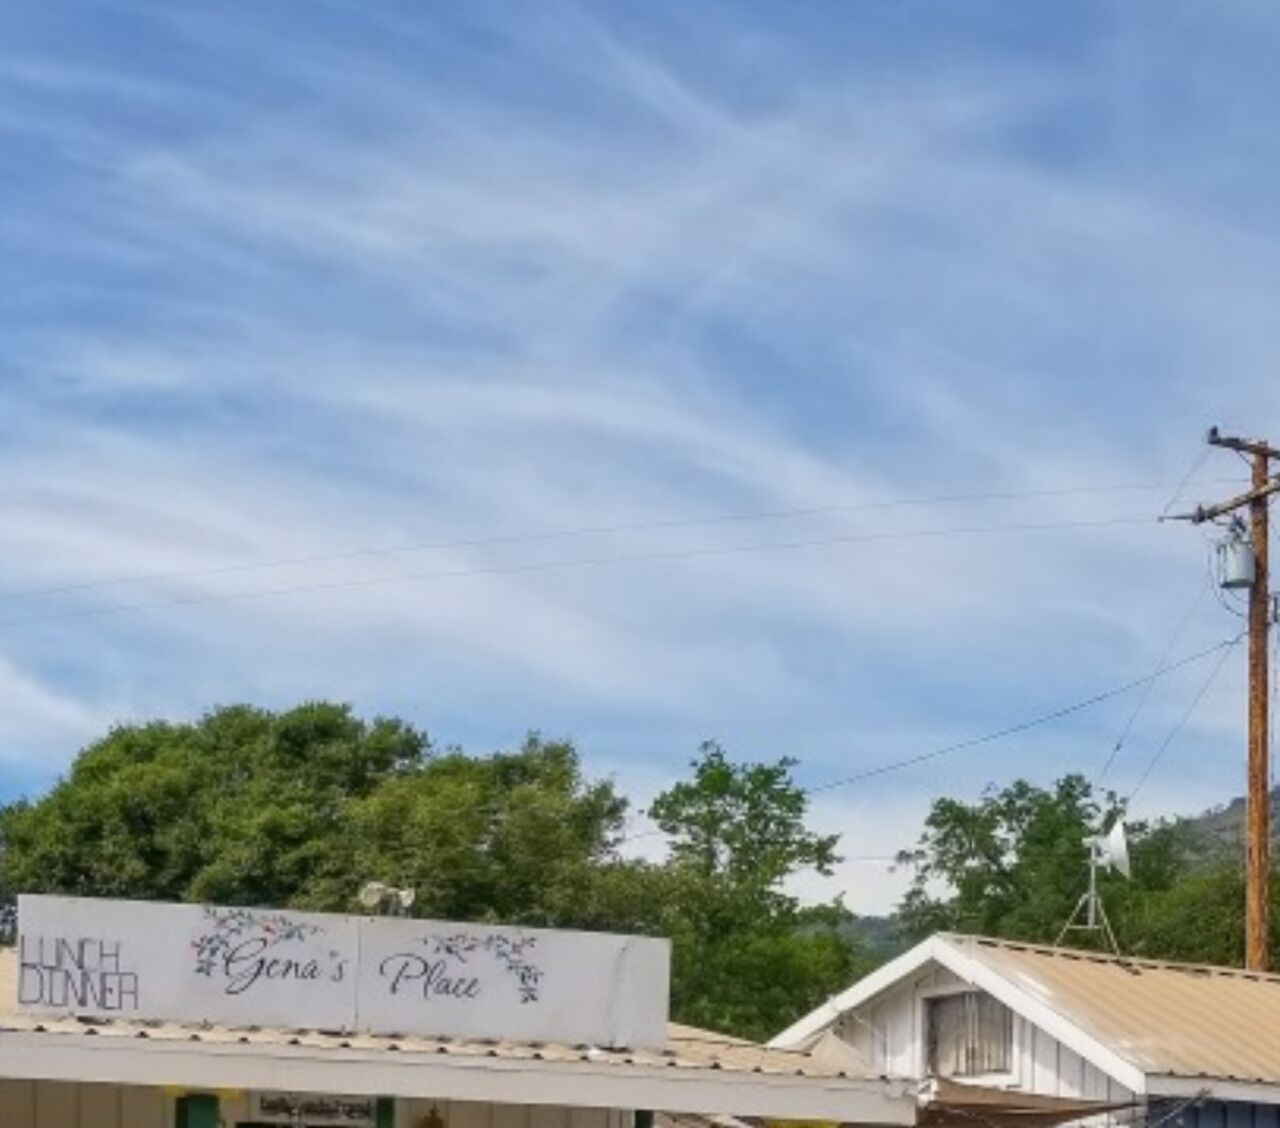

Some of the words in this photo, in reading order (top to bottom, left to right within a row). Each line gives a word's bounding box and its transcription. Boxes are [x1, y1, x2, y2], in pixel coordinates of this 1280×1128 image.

[20, 934, 121, 974] LUNCH
[222, 937, 348, 995] Gena's
[379, 952, 481, 1000] Place
[18, 962, 139, 1010] DINNER
